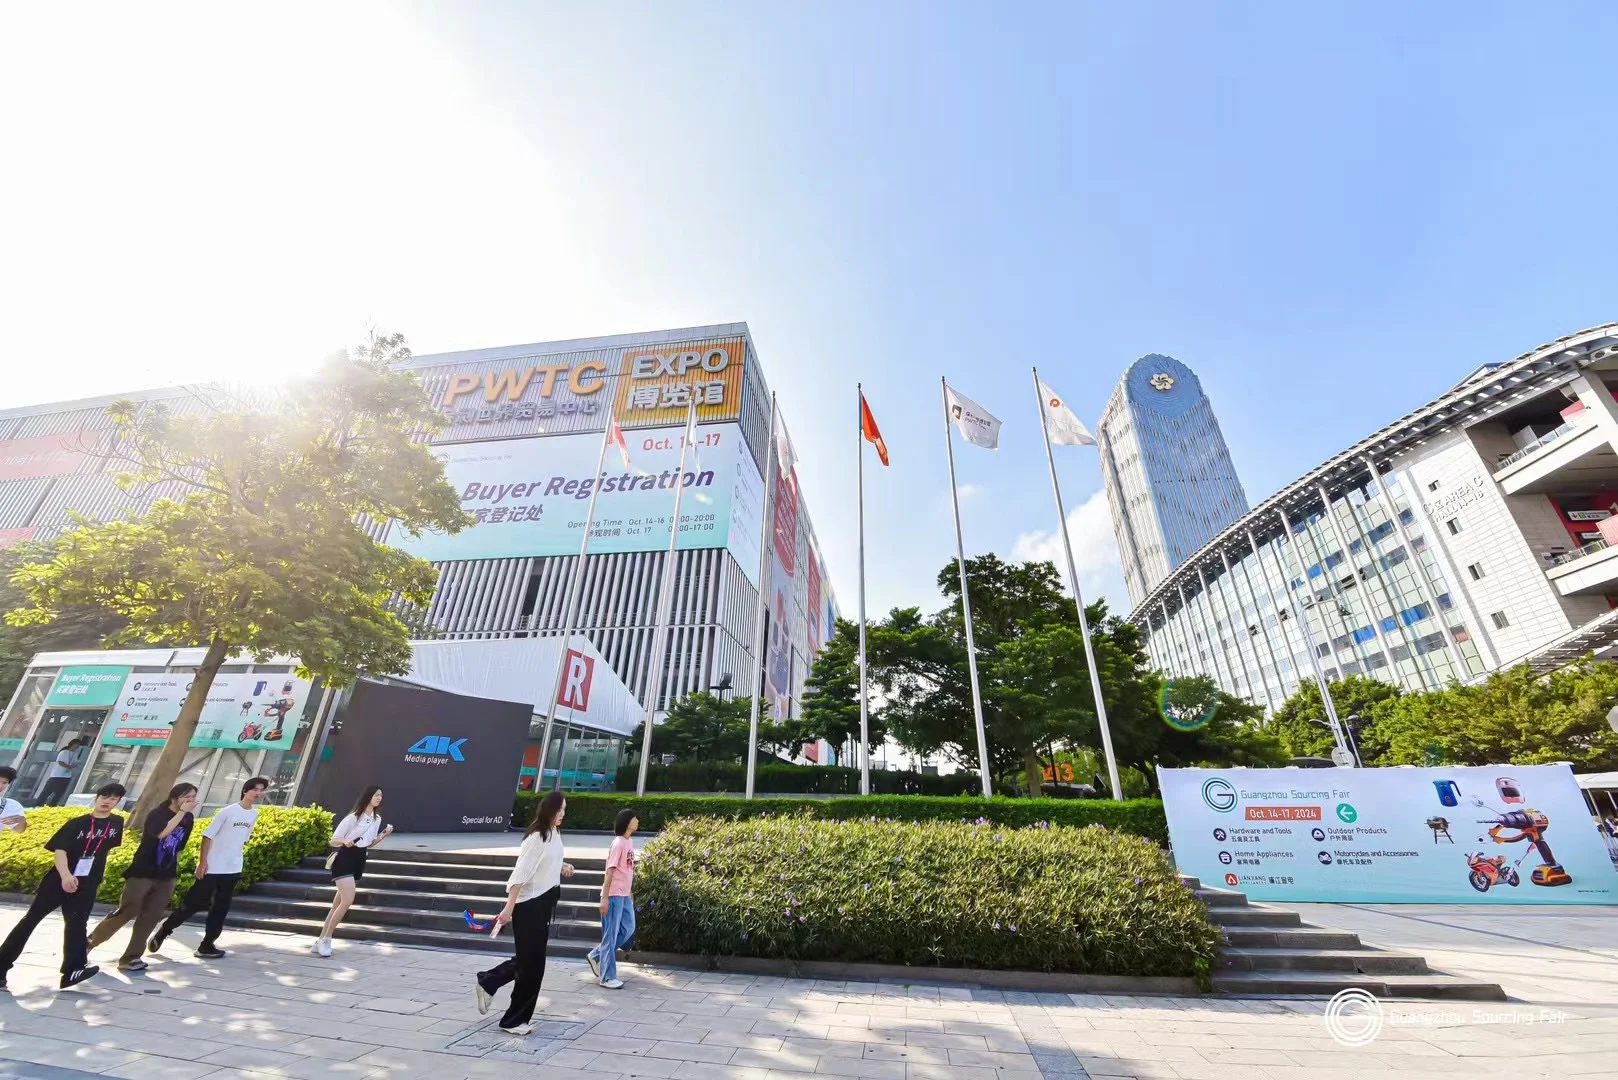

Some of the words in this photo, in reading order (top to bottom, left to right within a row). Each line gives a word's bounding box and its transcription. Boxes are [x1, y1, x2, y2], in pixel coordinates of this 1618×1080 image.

[632, 348, 728, 379] EXPO
[443, 361, 606, 406] PWTC
[627, 379, 725, 409] 博览馆
[643, 438, 673, 451] Oct.
[679, 433, 721, 449] 1-17
[462, 481, 542, 504] Buyer
[544, 467, 714, 500] Registration
[567, 519, 600, 529] Openng
[603, 518, 622, 526] Time
[563, 655, 588, 706] R
[408, 735, 468, 761] 4K
[405, 754, 426, 763] Media
[426, 756, 449, 766] player
[1240, 790, 1288, 799] Guangzhou
[1291, 790, 1330, 799] Sourcing
[1332, 789, 1350, 798] Fair
[461, 815, 485, 825] Special
[484, 815, 493, 823] for
[493, 816, 503, 824] AD
[1250, 808, 1267, 818] Oct.
[1295, 808, 1317, 818] 2024
[1256, 851, 1294, 859] Appliances
[1334, 850, 1370, 858] Motorcycles
